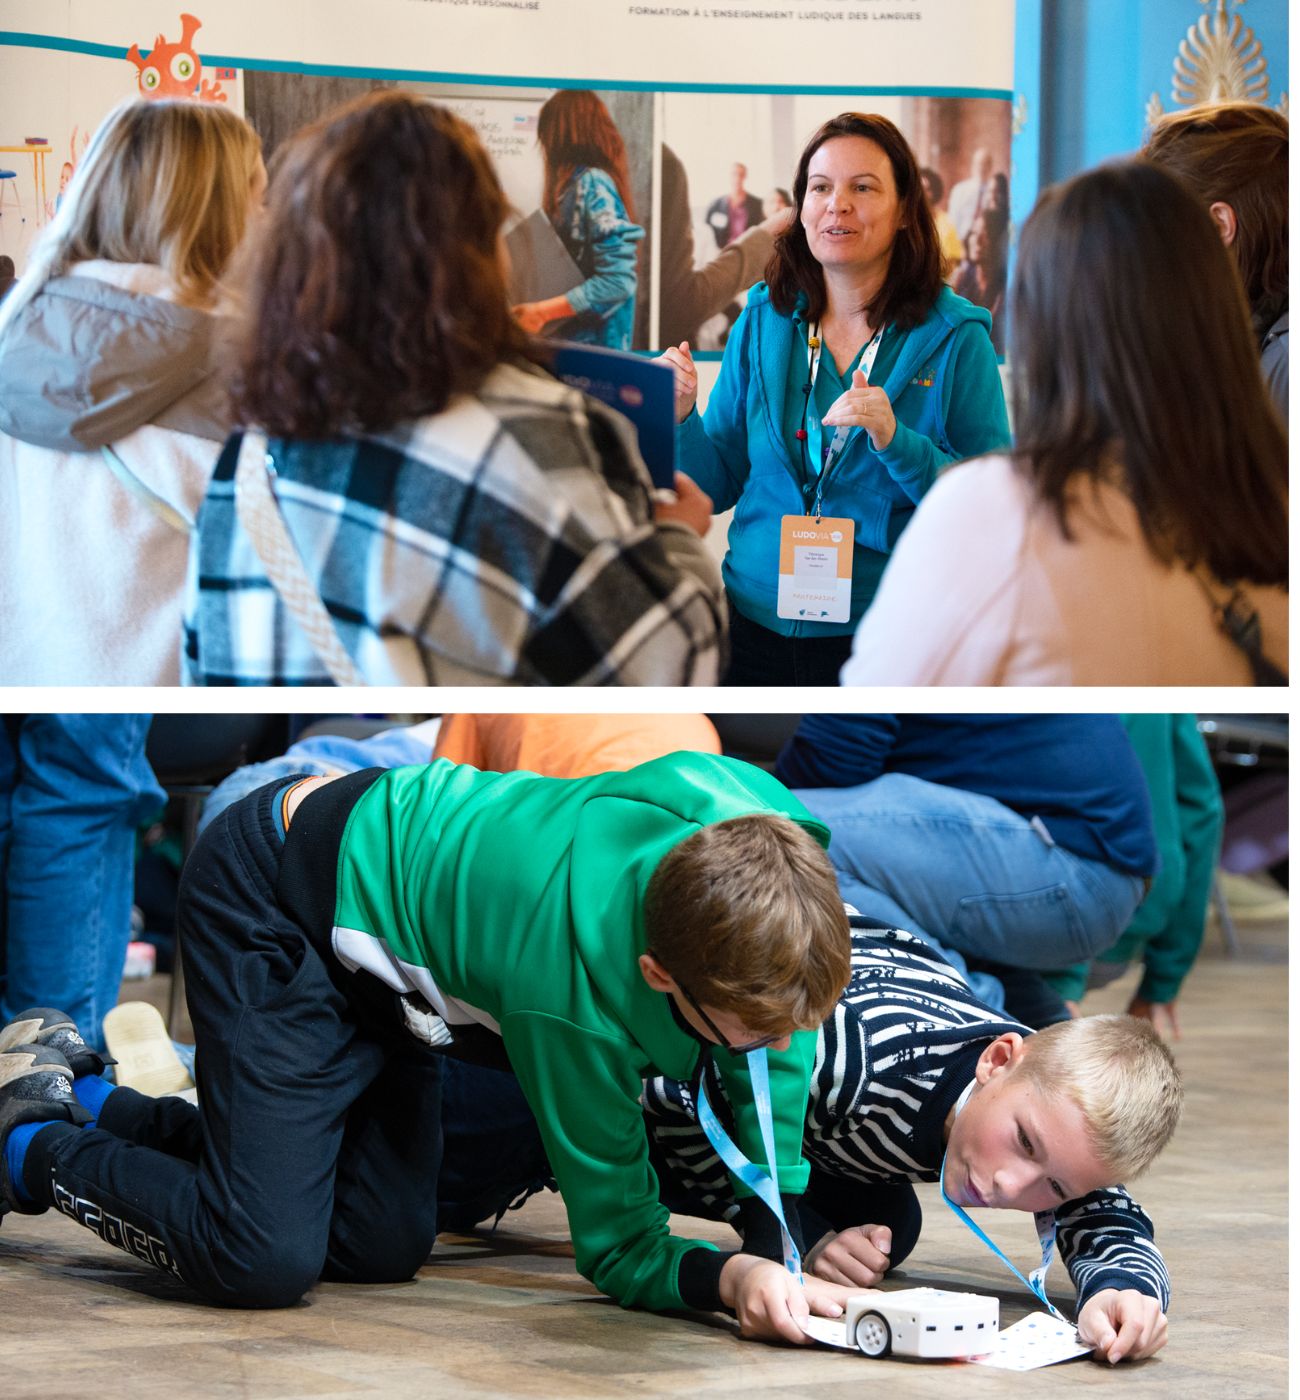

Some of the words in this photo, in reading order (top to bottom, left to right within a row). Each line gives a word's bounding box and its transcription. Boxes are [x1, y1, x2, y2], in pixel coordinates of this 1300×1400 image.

[629, 6, 690, 16] FORMATION
[704, 8, 794, 19] L'ENSEIGNEMENT
[799, 11, 843, 21] LUDIQUE
[848, 11, 868, 20] DES
[873, 11, 921, 20] LANGUES
